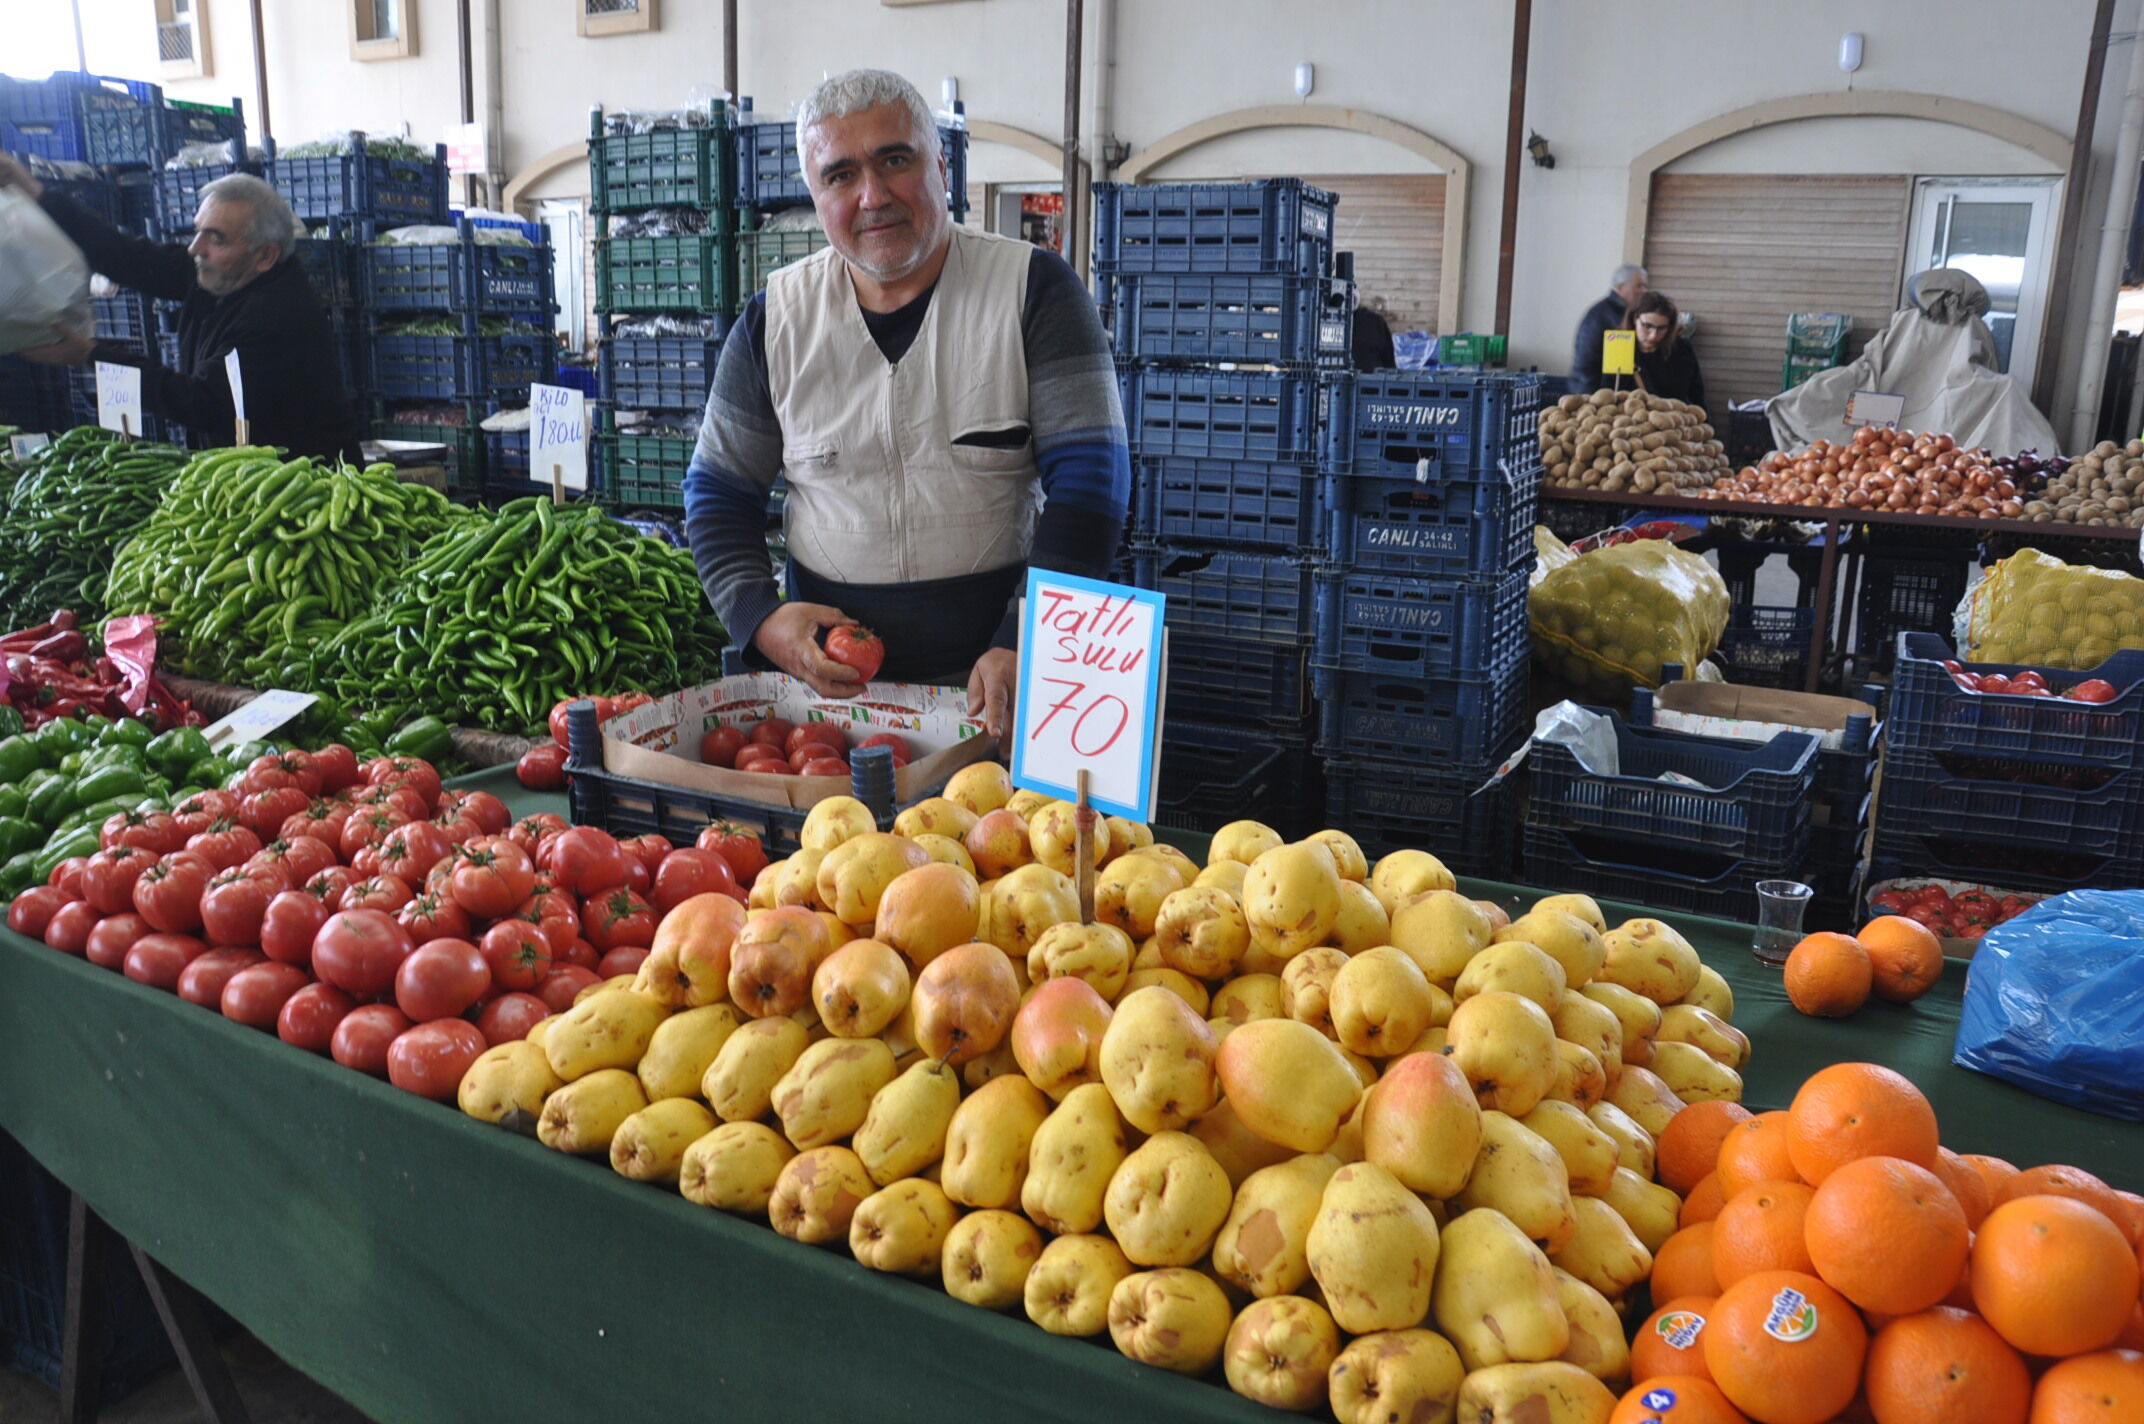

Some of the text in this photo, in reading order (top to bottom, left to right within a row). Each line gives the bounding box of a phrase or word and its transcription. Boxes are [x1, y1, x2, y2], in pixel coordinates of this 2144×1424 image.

[1405, 406, 1460, 425] CANLI
[1367, 527, 1419, 547] CANLI
[1390, 606, 1442, 626] CANLI
[1031, 676, 1129, 757] 70
[1649, 1392, 1671, 1410] 4
